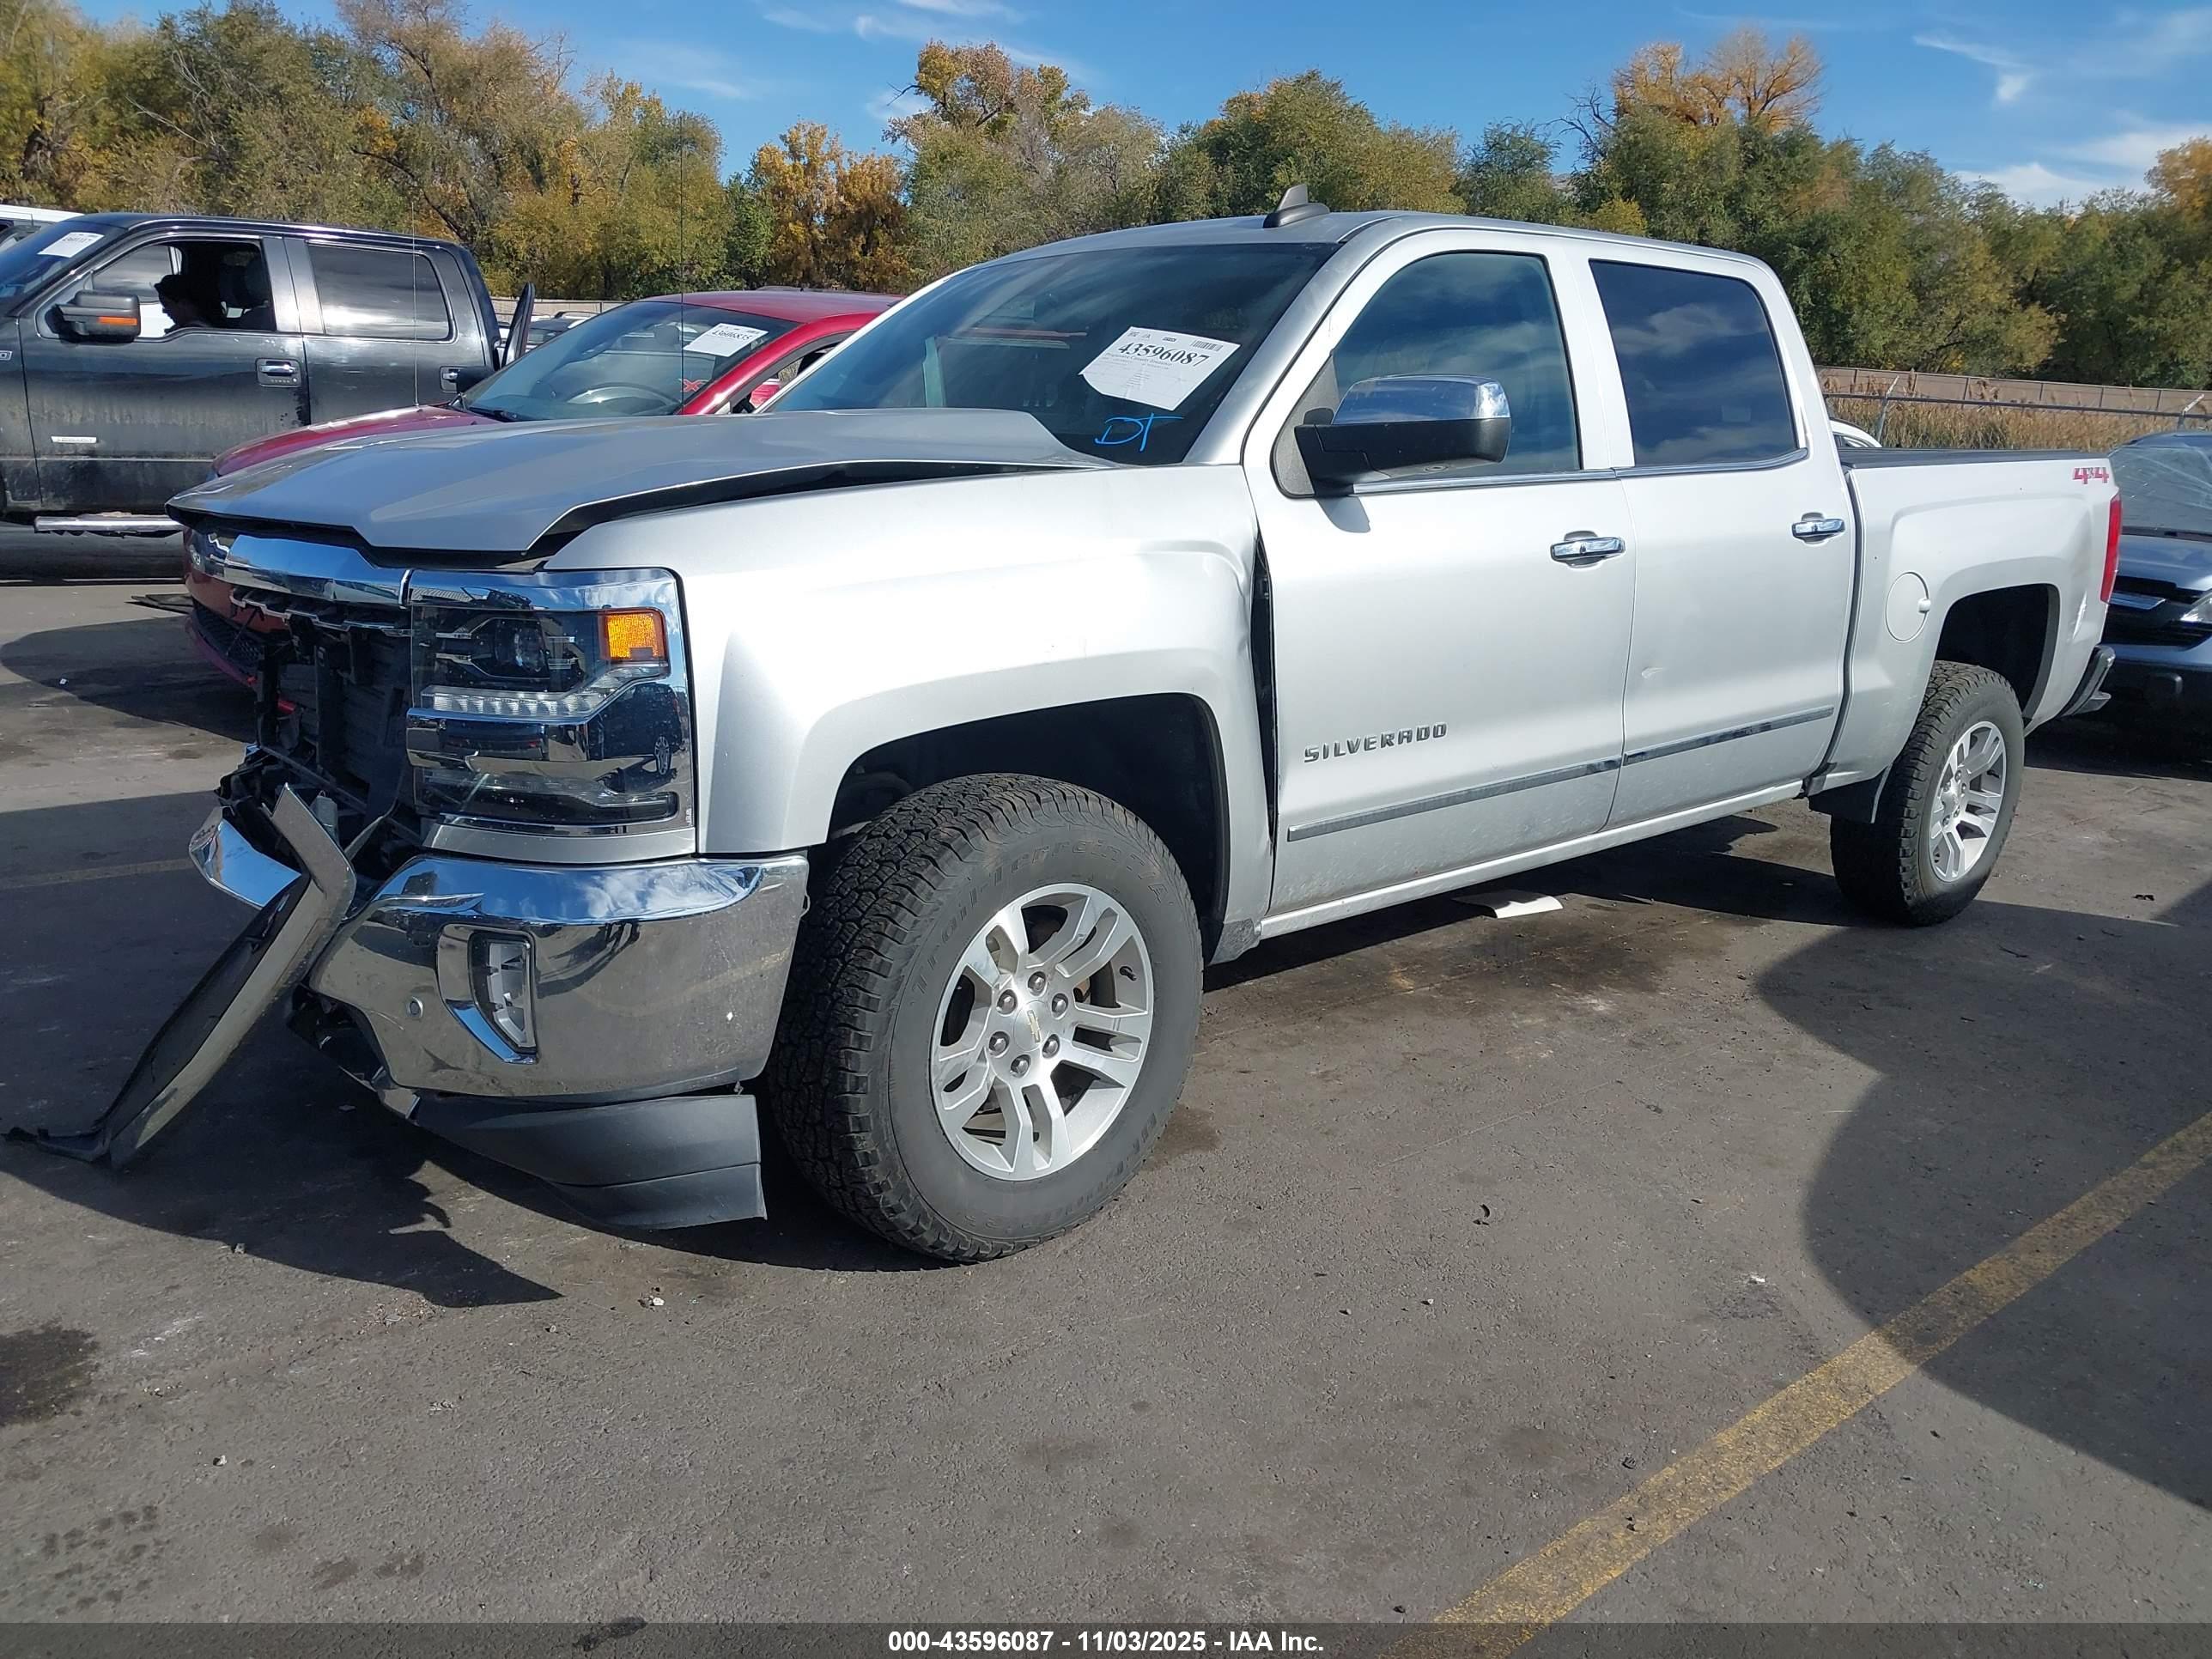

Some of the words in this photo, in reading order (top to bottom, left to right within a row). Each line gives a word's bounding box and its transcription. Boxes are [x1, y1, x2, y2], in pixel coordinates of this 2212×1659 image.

[1118, 343, 1210, 367] 43596087
[1095, 412, 1184, 452] DT
[1304, 723, 1447, 763] SILVERADO
